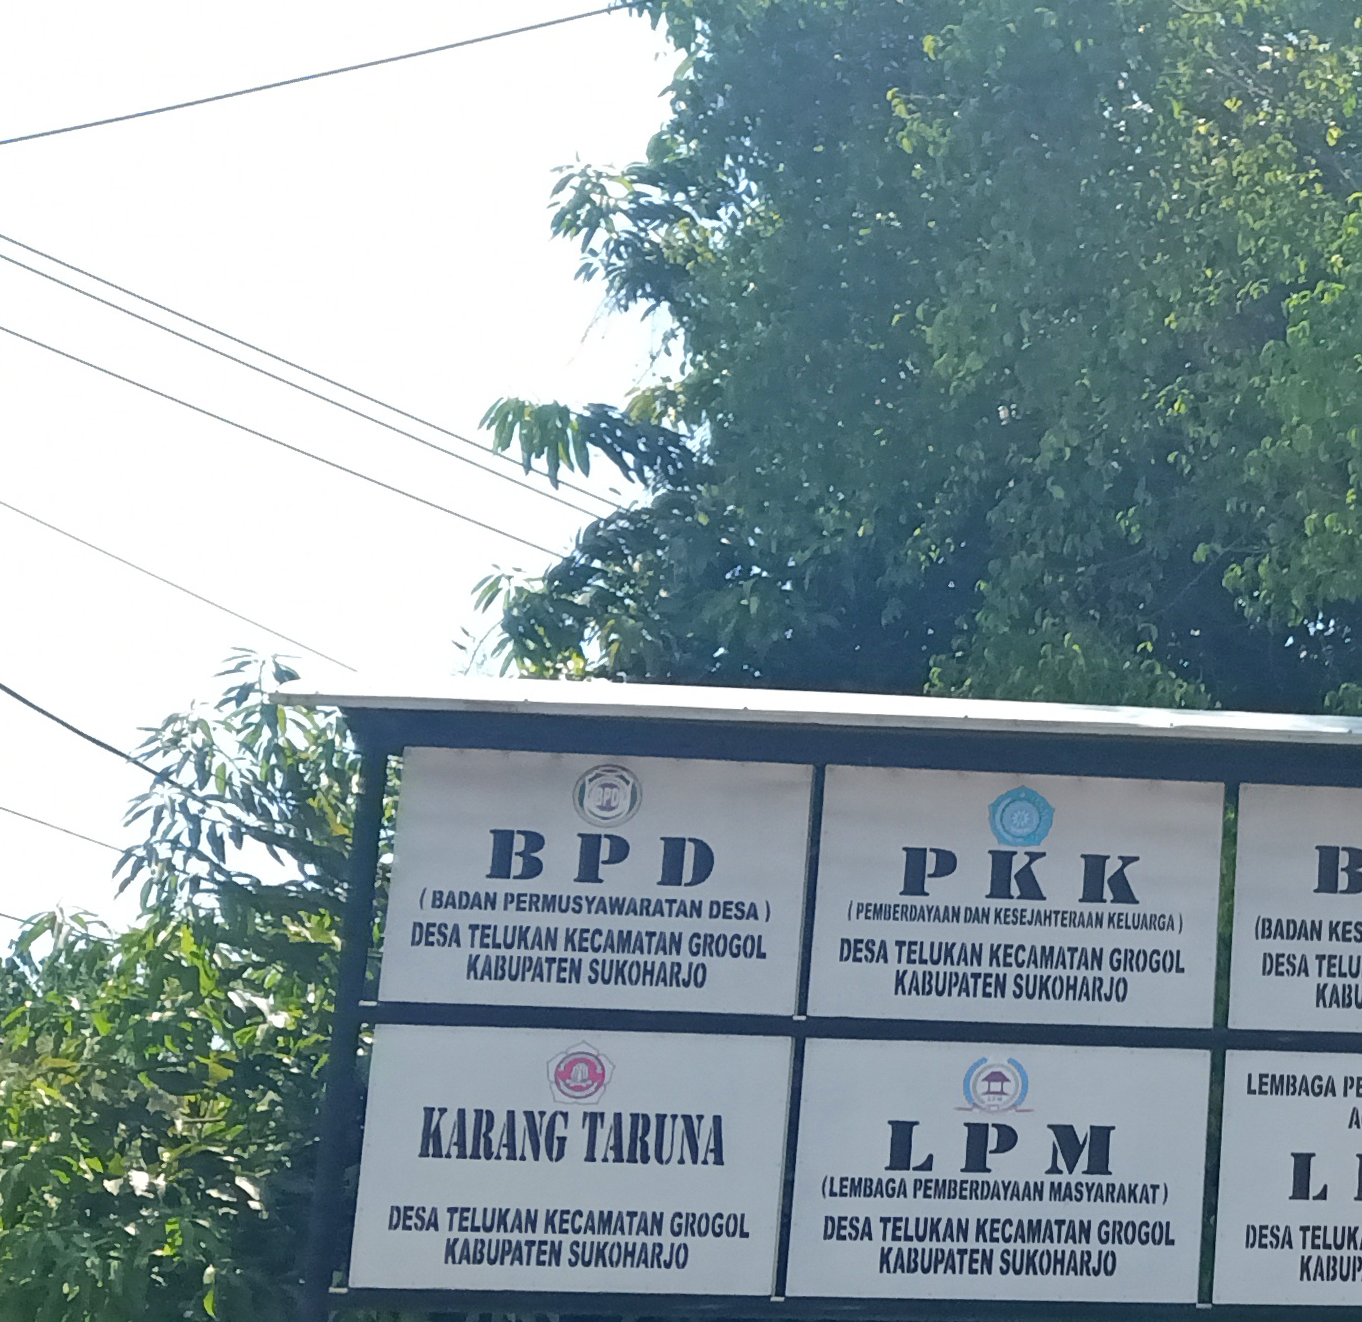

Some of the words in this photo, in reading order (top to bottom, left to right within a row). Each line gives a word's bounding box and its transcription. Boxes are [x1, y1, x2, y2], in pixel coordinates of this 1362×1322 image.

[504, 893, 702, 918] PERMUSYAWARATAN
[964, 907, 990, 924] DAN
[994, 908, 1104, 928] KESEJAHTERAAN
[411, 922, 461, 947] DESA
[469, 924, 558, 951] TELUKAN
[564, 928, 682, 955] KECAMATAN
[689, 933, 766, 959] GROGOL
[840, 938, 888, 963] DESA
[895, 940, 983, 966] TELUKAN
[989, 944, 1103, 971] KECAMATAN
[1109, 948, 1184, 973] GROGOL
[1262, 953, 1309, 977] DESA
[467, 954, 582, 984] KABUPATEN
[588, 959, 706, 988] SUKOHARJO
[895, 970, 1007, 998] KABUPATEN
[1013, 974, 1127, 1002] SUKOHARJO
[1247, 1073, 1336, 1097] LEMBAGA
[418, 1107, 568, 1162] KARANG
[582, 1111, 724, 1166] TARUNA
[913, 1179, 1044, 1201] PEMBERDAYAAN
[388, 1206, 439, 1231] DESA
[447, 1207, 538, 1233] TELUKAN
[544, 1209, 664, 1236] KECAMATAN
[670, 1212, 749, 1238] GROGOL
[823, 1216, 872, 1241] DESA
[880, 1217, 969, 1242] TELUKAN
[975, 1218, 1091, 1244] KECAMATAN
[1098, 1220, 1175, 1245] GROGOL
[1246, 1225, 1293, 1249] DESA
[445, 1238, 562, 1266] KABUPATEN
[568, 1241, 688, 1269] SUKOHARJO
[880, 1247, 993, 1275] KABUPATEN
[1000, 1249, 1116, 1276] SUKOHARJO
